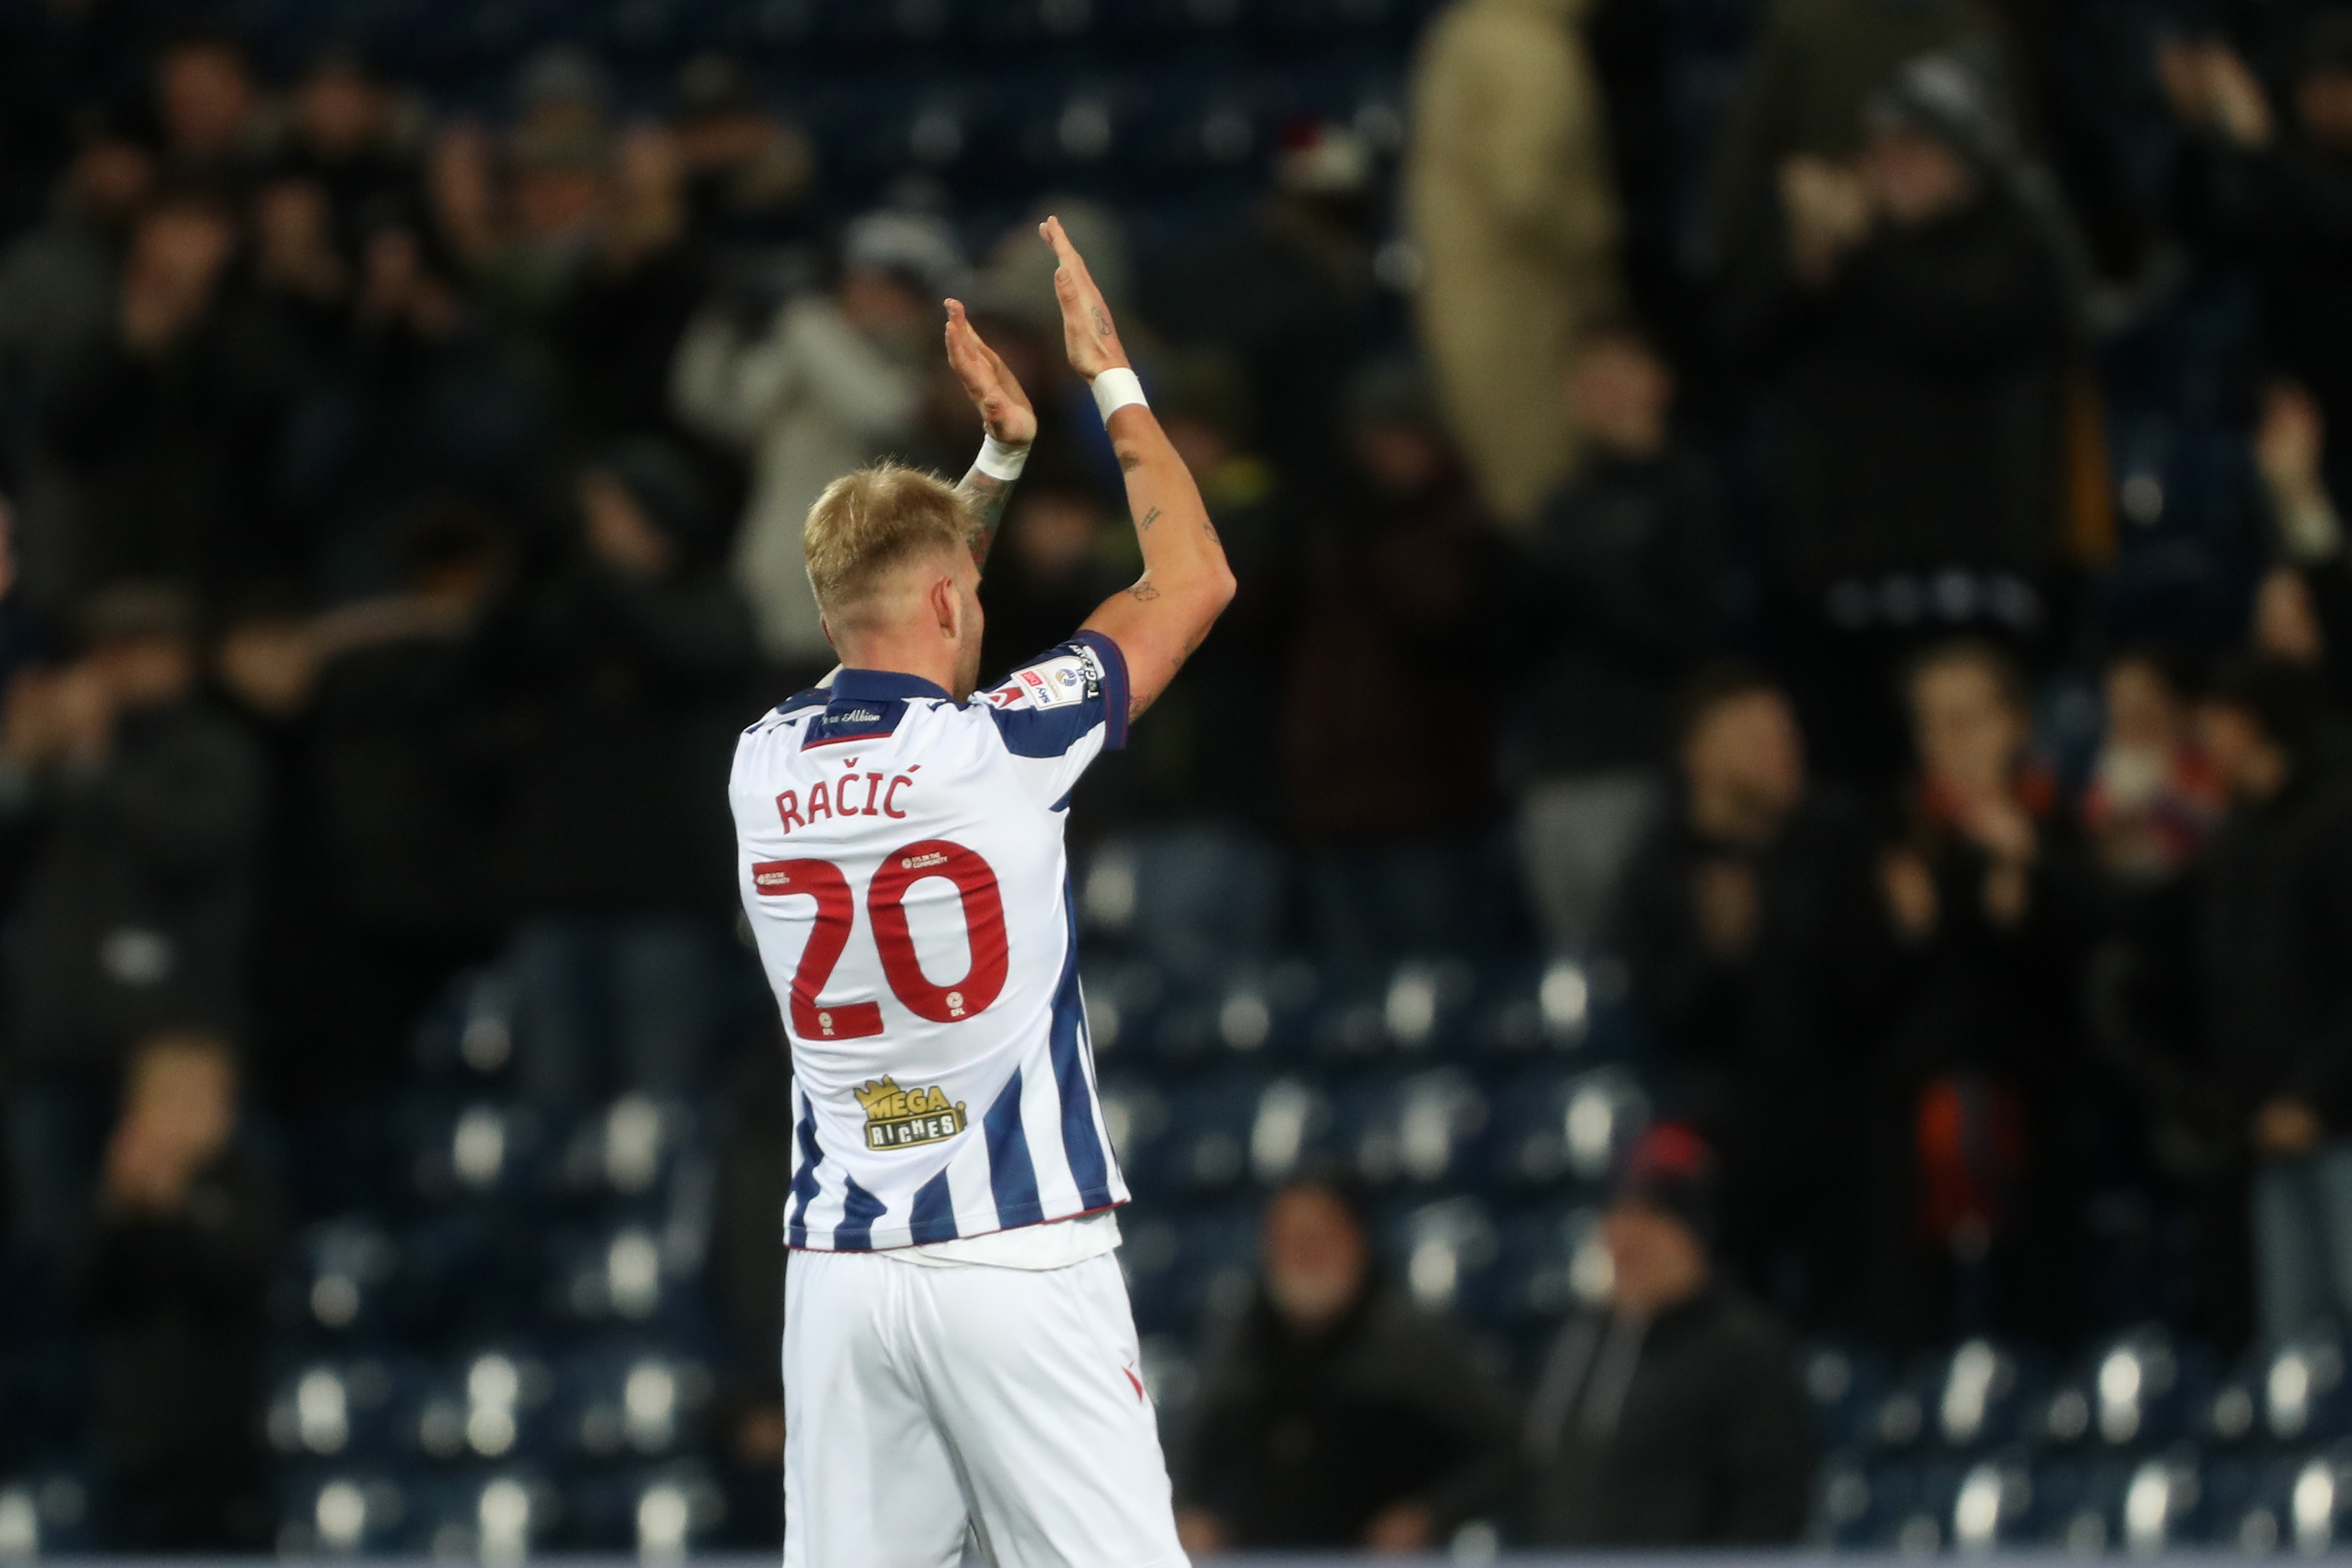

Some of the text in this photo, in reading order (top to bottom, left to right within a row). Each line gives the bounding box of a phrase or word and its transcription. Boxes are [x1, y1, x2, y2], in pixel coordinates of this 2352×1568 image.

[1021, 671, 1051, 703] sky bet
[842, 709, 881, 723] Albion
[775, 757, 921, 834] RAČIĆ
[752, 839, 1008, 1041] 20
[867, 1085, 950, 1120] MEGA
[871, 1115, 955, 1146] RICHES
